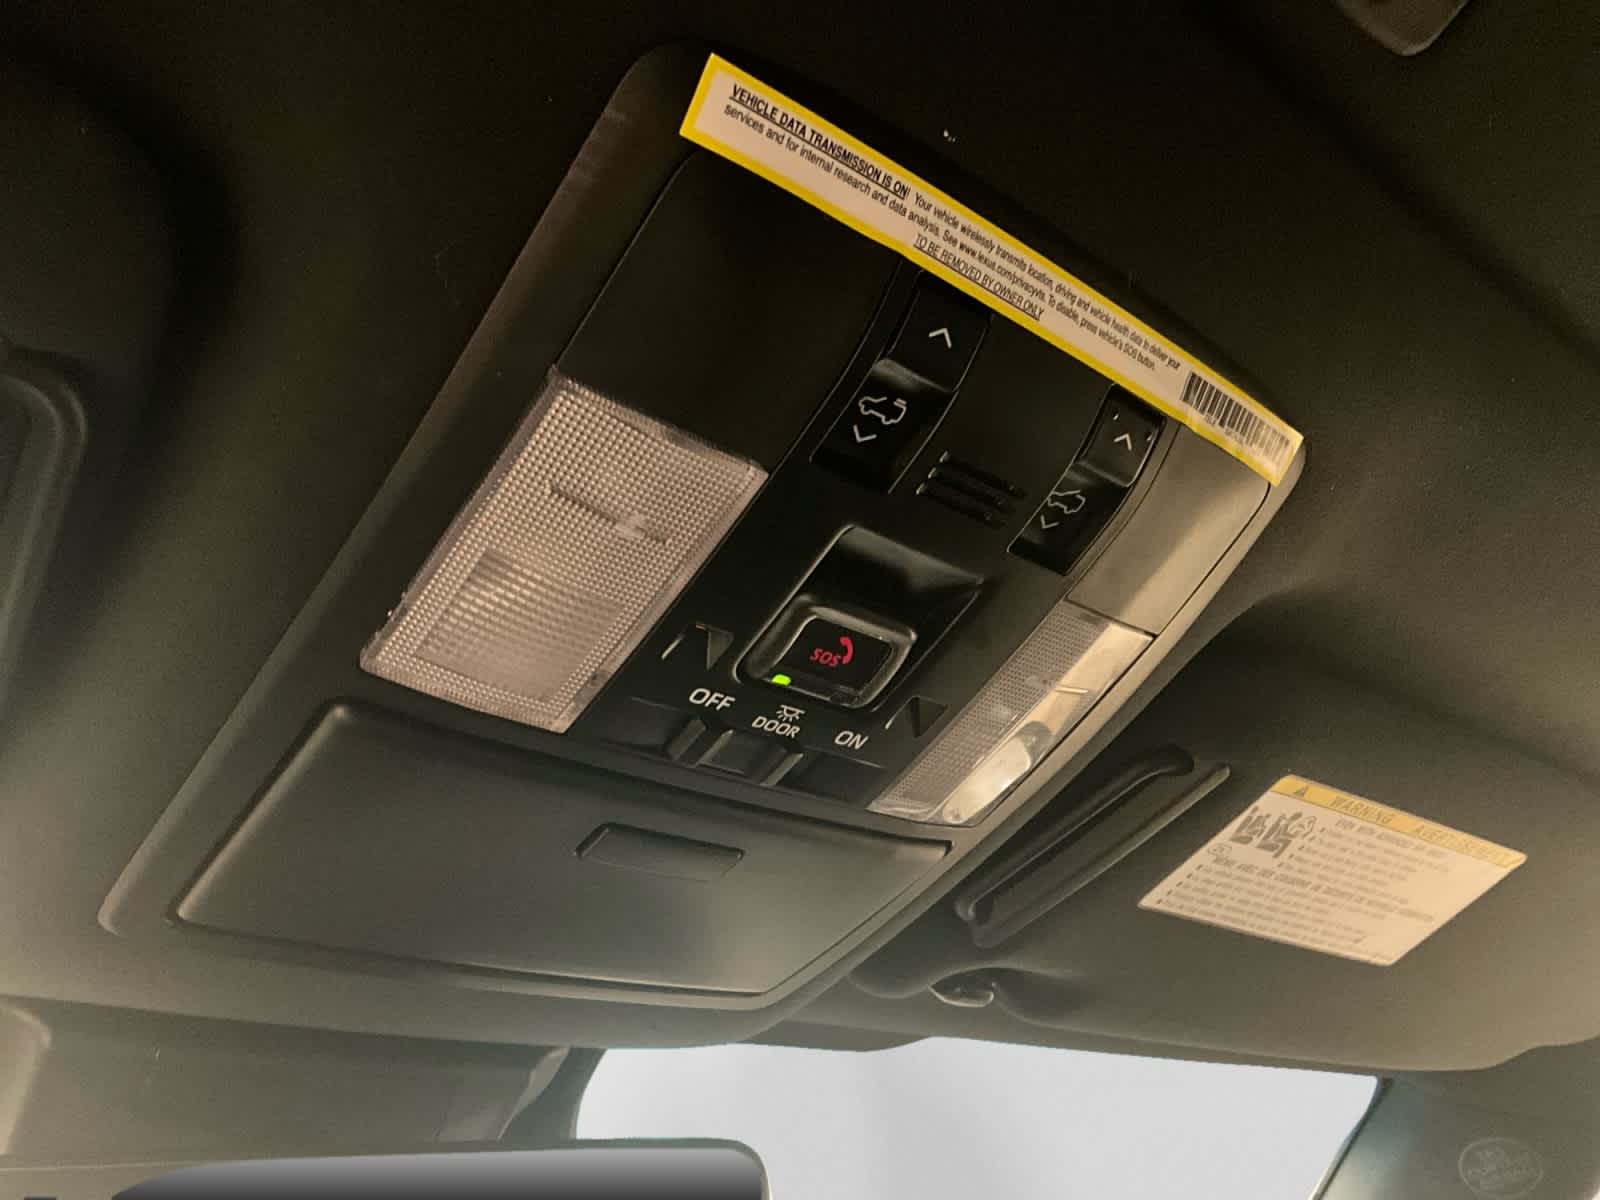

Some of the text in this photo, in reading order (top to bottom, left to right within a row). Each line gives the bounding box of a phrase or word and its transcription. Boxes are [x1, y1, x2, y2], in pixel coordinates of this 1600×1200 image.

[724, 104, 765, 134] services
[765, 128, 786, 145] and
[785, 136, 800, 153] for
[799, 144, 835, 173] internal
[833, 167, 871, 196] research
[871, 190, 890, 206] and
[888, 199, 908, 217] data
[942, 229, 959, 248] See
[1047, 293, 1056, 308] To
[732, 84, 779, 122] VEHICLE
[779, 112, 807, 138] DATA
[809, 129, 882, 183] TRANSMISSION
[881, 173, 893, 189] IS
[914, 192, 933, 212] Your
[933, 206, 960, 230] vehicle
[960, 224, 995, 254] wirelessly
[995, 244, 1028, 272] transmits
[1054, 283, 1078, 306] driving
[1076, 298, 1091, 312] and
[1166, 357, 1181, 370] your
[914, 232, 1045, 320] TO BE REMOVED BY OWNER ONLY
[809, 647, 841, 667] SOS
[689, 687, 736, 711] OFF
[752, 715, 801, 738] DOOR
[834, 730, 869, 750] ON
[1329, 796, 1394, 825] WARNING
